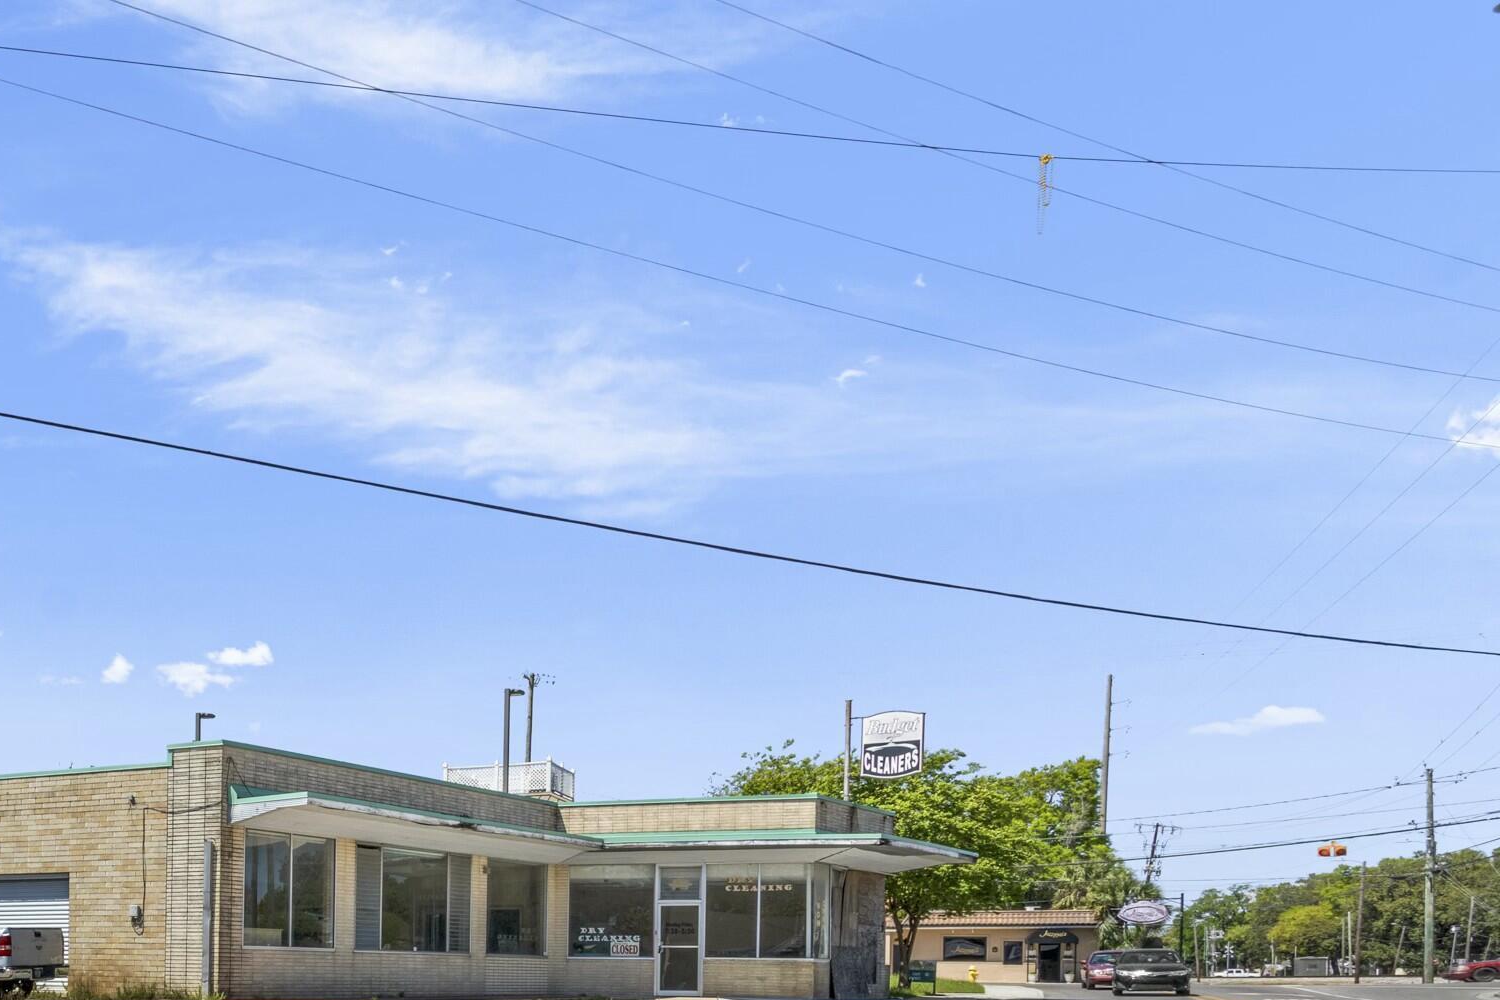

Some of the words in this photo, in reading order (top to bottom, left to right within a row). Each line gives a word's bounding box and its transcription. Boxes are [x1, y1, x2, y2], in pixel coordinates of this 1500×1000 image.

[865, 717, 920, 737] Budget
[864, 749, 919, 775] CLEANERS
[724, 884, 794, 892] CLEANING
[578, 935, 641, 943] CLEANING
[611, 944, 639, 955] CLOSED
